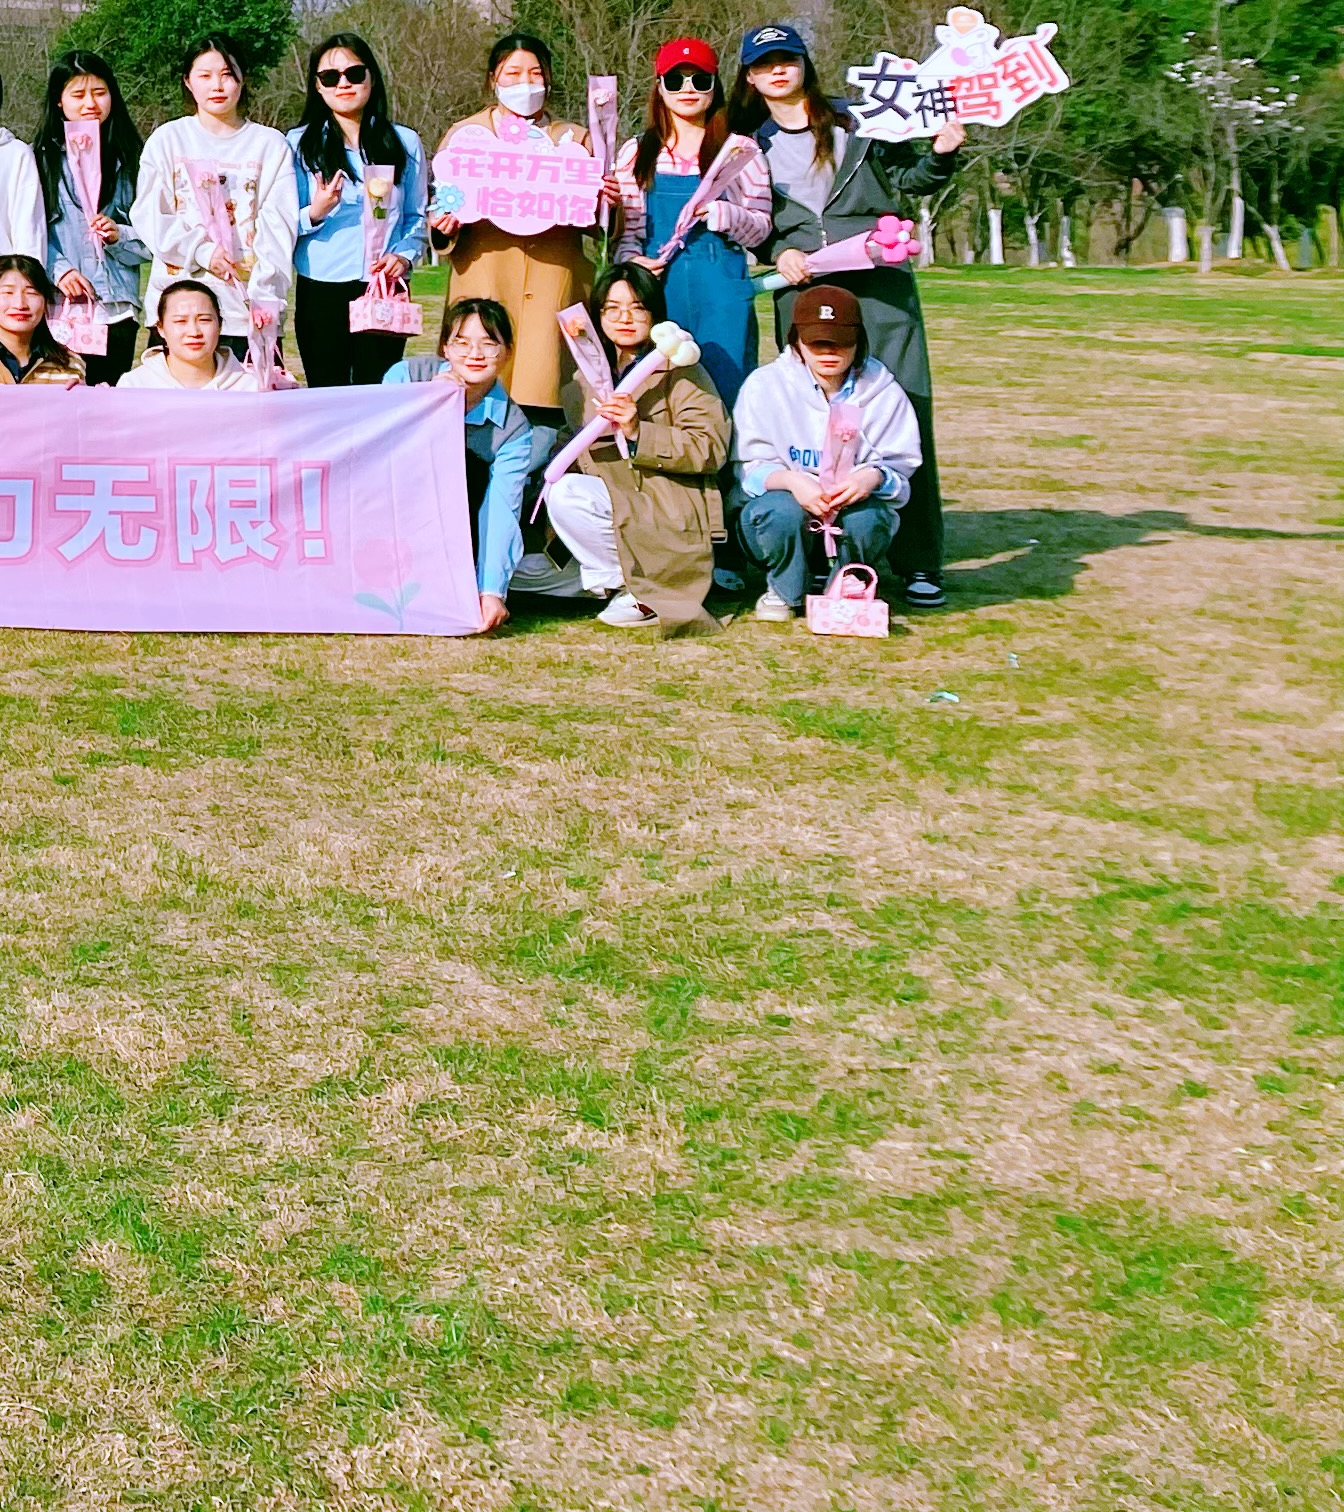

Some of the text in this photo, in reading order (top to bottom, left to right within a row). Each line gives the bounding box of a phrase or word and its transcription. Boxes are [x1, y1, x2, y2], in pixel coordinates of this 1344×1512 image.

[858, 40, 1059, 129] 女神驾到
[449, 146, 602, 187] 花开万里
[477, 187, 594, 224] 恰如你
[819, 305, 836, 320] R
